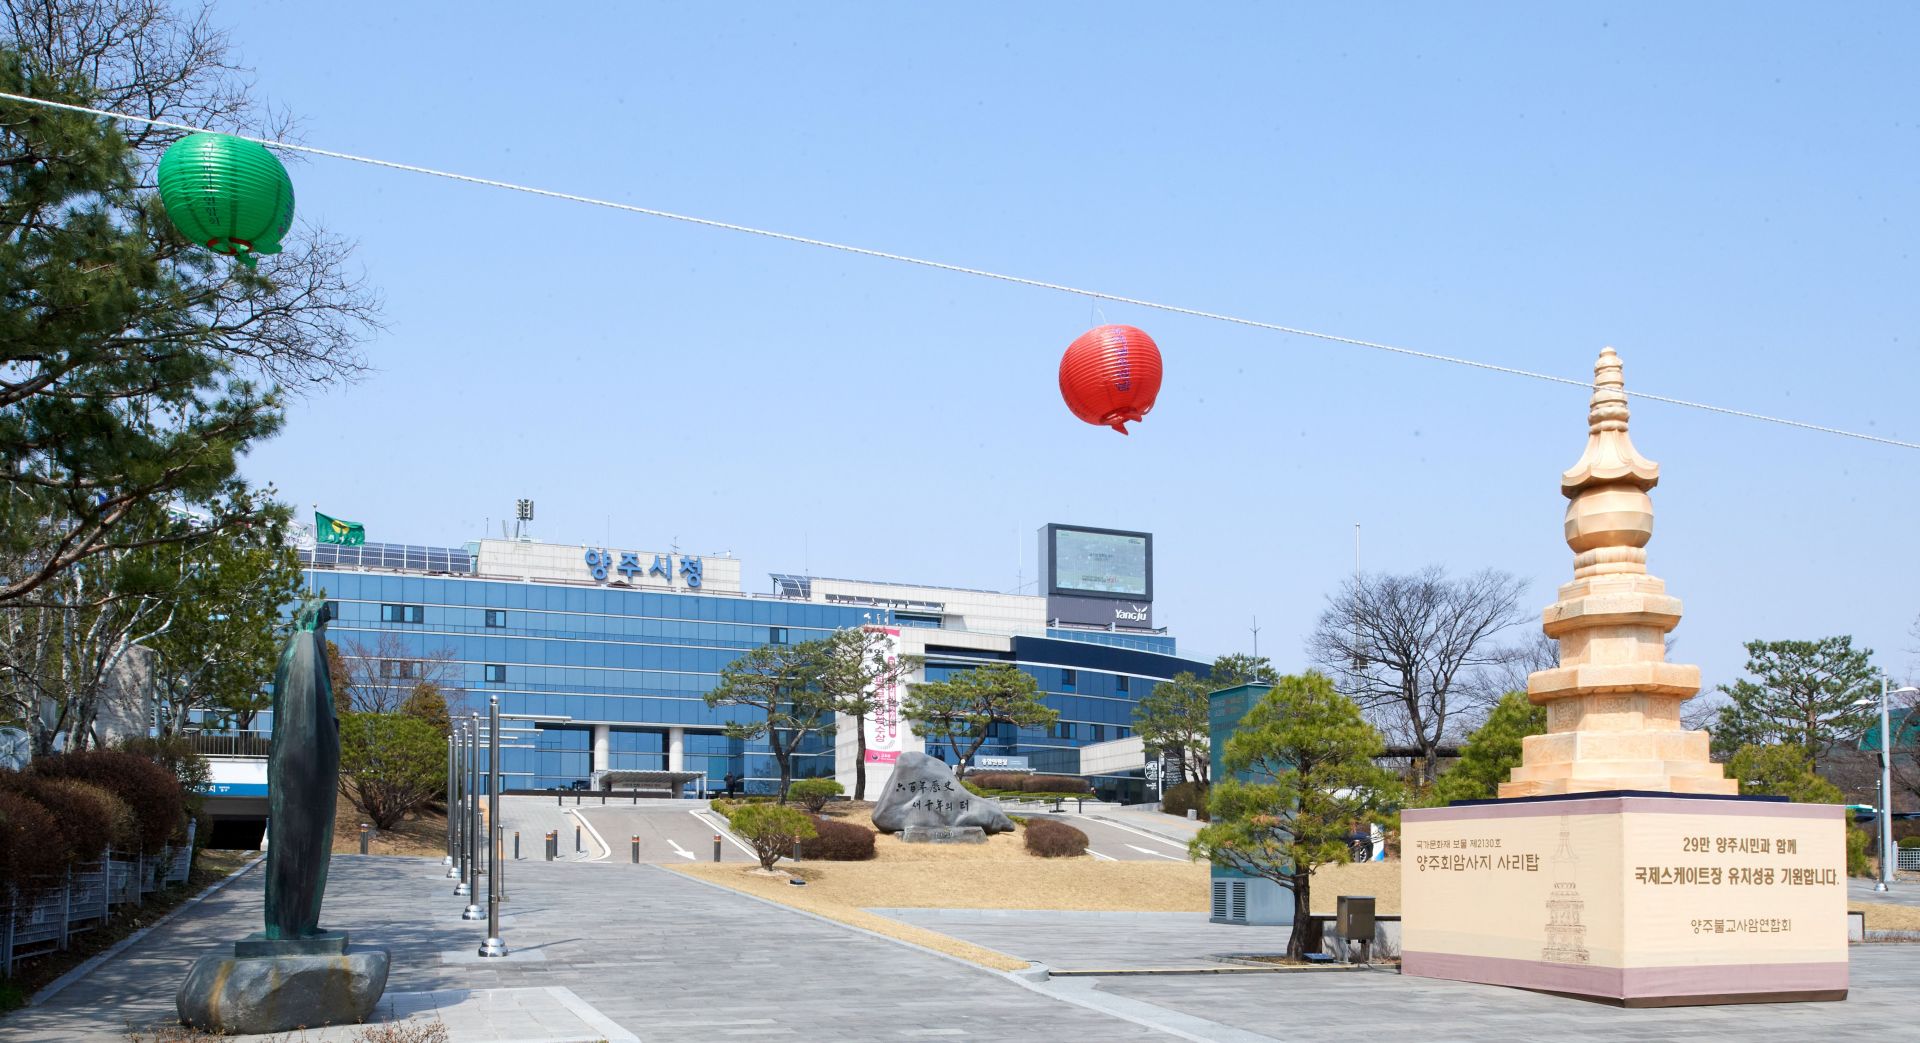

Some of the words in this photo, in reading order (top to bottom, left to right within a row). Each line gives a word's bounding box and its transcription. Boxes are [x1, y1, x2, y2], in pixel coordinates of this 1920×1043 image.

[585, 550, 703, 587] 양주시청
[1416, 839, 1450, 849] 국가문화재
[1453, 838, 1467, 849] 보물
[1470, 838, 1502, 848] 제2130호
[1683, 837, 1710, 852] 29만
[1716, 837, 1770, 854] 양주시민과
[1776, 838, 1797, 854] 함께
[1416, 854, 1492, 872] 양주회암사지
[1497, 854, 1540, 872] 사리탑
[1635, 867, 1722, 885] 국제스케이트장
[1728, 867, 1775, 885] 유치성공
[1781, 868, 1840, 886] 기원합니다.
[1691, 919, 1792, 934] 양주불교사암연합회
